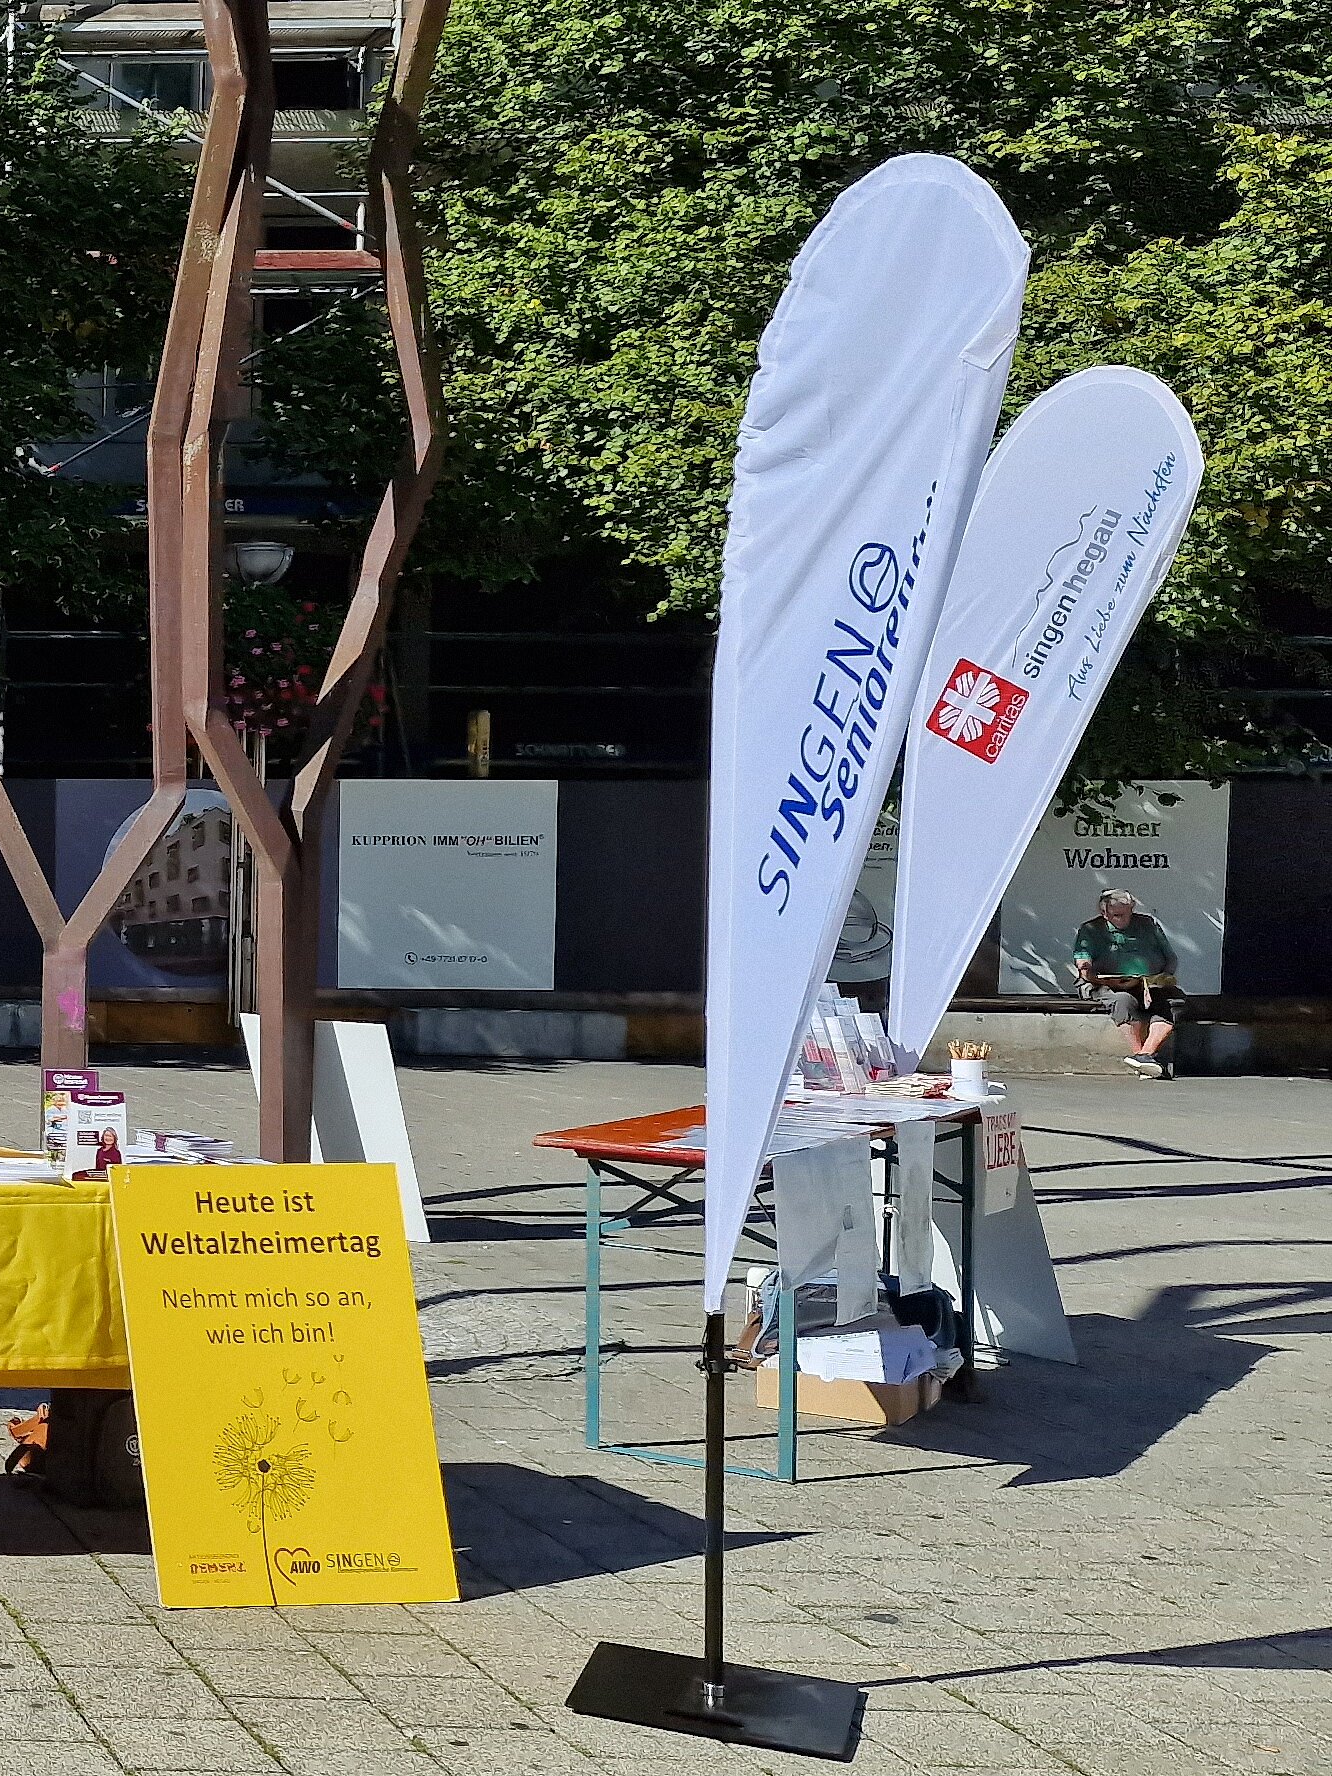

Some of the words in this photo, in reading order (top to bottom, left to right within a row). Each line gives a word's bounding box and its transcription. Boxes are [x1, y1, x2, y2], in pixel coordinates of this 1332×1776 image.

[1068, 656, 1094, 702] Aus
[1084, 601, 1116, 654] Liebe
[1115, 551, 1137, 594] zum
[1127, 451, 1176, 547] Nächsten
[986, 694, 1026, 758] caritas
[758, 617, 877, 915] SINGEN
[351, 836, 427, 847] KUPPRION
[1062, 847, 1171, 869] Wohnen
[986, 1131, 1016, 1170] LIEBE
[195, 1190, 275, 1214] Heute
[283, 1190, 315, 1214] ist
[140, 1231, 381, 1258] Weltalzheimertag
[162, 1288, 237, 1309] Nehmt
[245, 1286, 298, 1309] mich
[306, 1291, 330, 1309] so
[338, 1291, 373, 1311] an,
[206, 1324, 244, 1344] wie
[252, 1324, 283, 1344] ich
[291, 1322, 335, 1344] bin!
[290, 1560, 321, 1574] AWO
[326, 1553, 384, 1568] SINGEN
